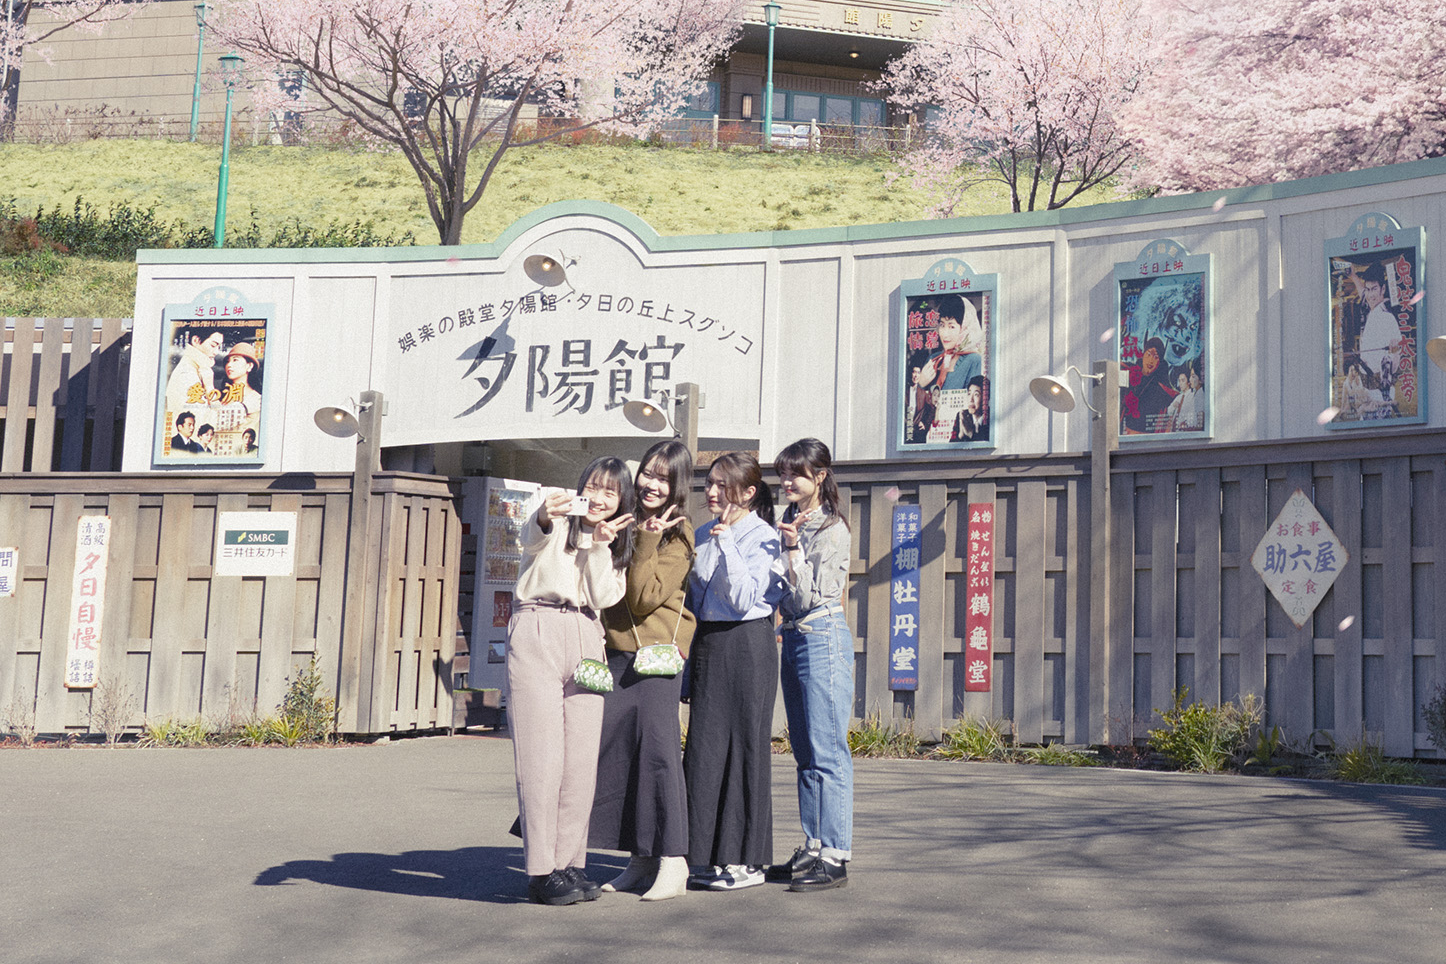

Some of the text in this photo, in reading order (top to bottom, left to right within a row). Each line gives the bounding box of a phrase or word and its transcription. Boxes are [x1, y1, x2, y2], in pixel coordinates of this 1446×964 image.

[1349, 235, 1395, 251] 近日上映
[1139, 260, 1184, 275] 近日上映
[927, 279, 971, 292] 近日上映
[194, 306, 245, 317] 近日上映
[453, 335, 686, 419] 夕陽館
[185, 382, 246, 406] 愛の淵
[970, 510, 992, 523] 名物
[80, 522, 93, 546] 清酒
[94, 522, 106, 546] 高級
[247, 533, 276, 542] SMBC
[896, 512, 907, 543] 洋菓子
[907, 512, 918, 543] 和菓子
[1277, 520, 1321, 537] お食事
[223, 548, 288, 558] 三井住友カード
[1263, 540, 1337, 574] 助六屋
[1281, 579, 1319, 595] 定食
[72, 551, 101, 651] 夕日自慢
[893, 547, 919, 671] 棚牡丹堂
